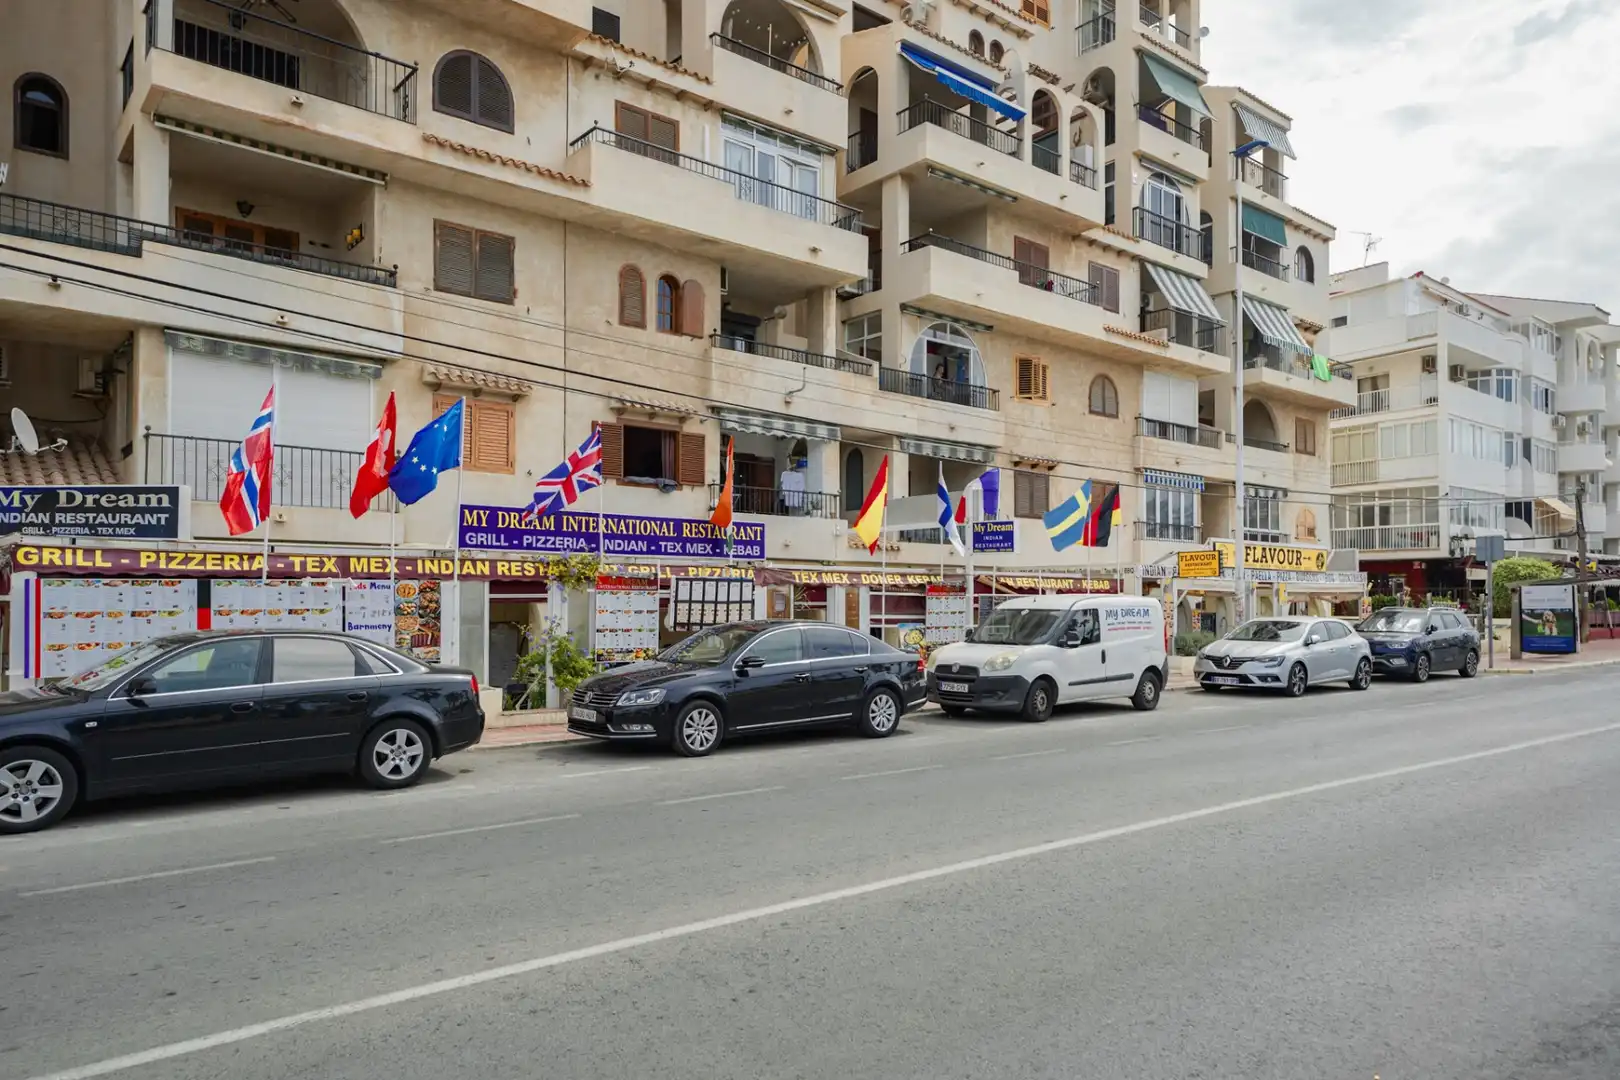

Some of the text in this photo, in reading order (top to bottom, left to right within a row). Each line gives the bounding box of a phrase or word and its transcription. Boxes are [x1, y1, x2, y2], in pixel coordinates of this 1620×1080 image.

[0, 489, 173, 512] My Dream
[55, 512, 169, 526] RESTAURANT
[463, 509, 488, 527] MY
[497, 511, 555, 531] DREAM
[562, 515, 677, 537] INTERNATIONAL
[22, 526, 45, 535] GRILL
[52, 526, 90, 535] PIZZERIA
[97, 527, 114, 535] TEX
[115, 527, 136, 535] MEX
[973, 523, 1014, 534] My Dream
[465, 532, 508, 546] GRILL
[523, 535, 587, 549] PIZZERIA
[603, 539, 647, 551] NDIAN
[659, 541, 682, 553] TEX
[686, 543, 712, 555] MEX
[1180, 553, 1217, 562] FLAVOUR
[1245, 545, 1302, 566] FLAVOUR
[16, 546, 112, 567] GRILL
[139, 551, 266, 571] PIZZERIA
[289, 556, 337, 573] TEX
[350, 557, 400, 574] MEX
[417, 559, 491, 575] INDIAN
[688, 567, 755, 579] PIZZRIA
[1142, 564, 1166, 577] INDIAN
[792, 571, 818, 584] TEX
[821, 573, 850, 585] MEX
[1015, 577, 1074, 589] RESTAURANT
[1082, 579, 1110, 590] KEBAB
[370, 582, 391, 590] Menu
[1105, 609, 1149, 620] MY DREAM
[347, 622, 392, 632] Barnmeny
